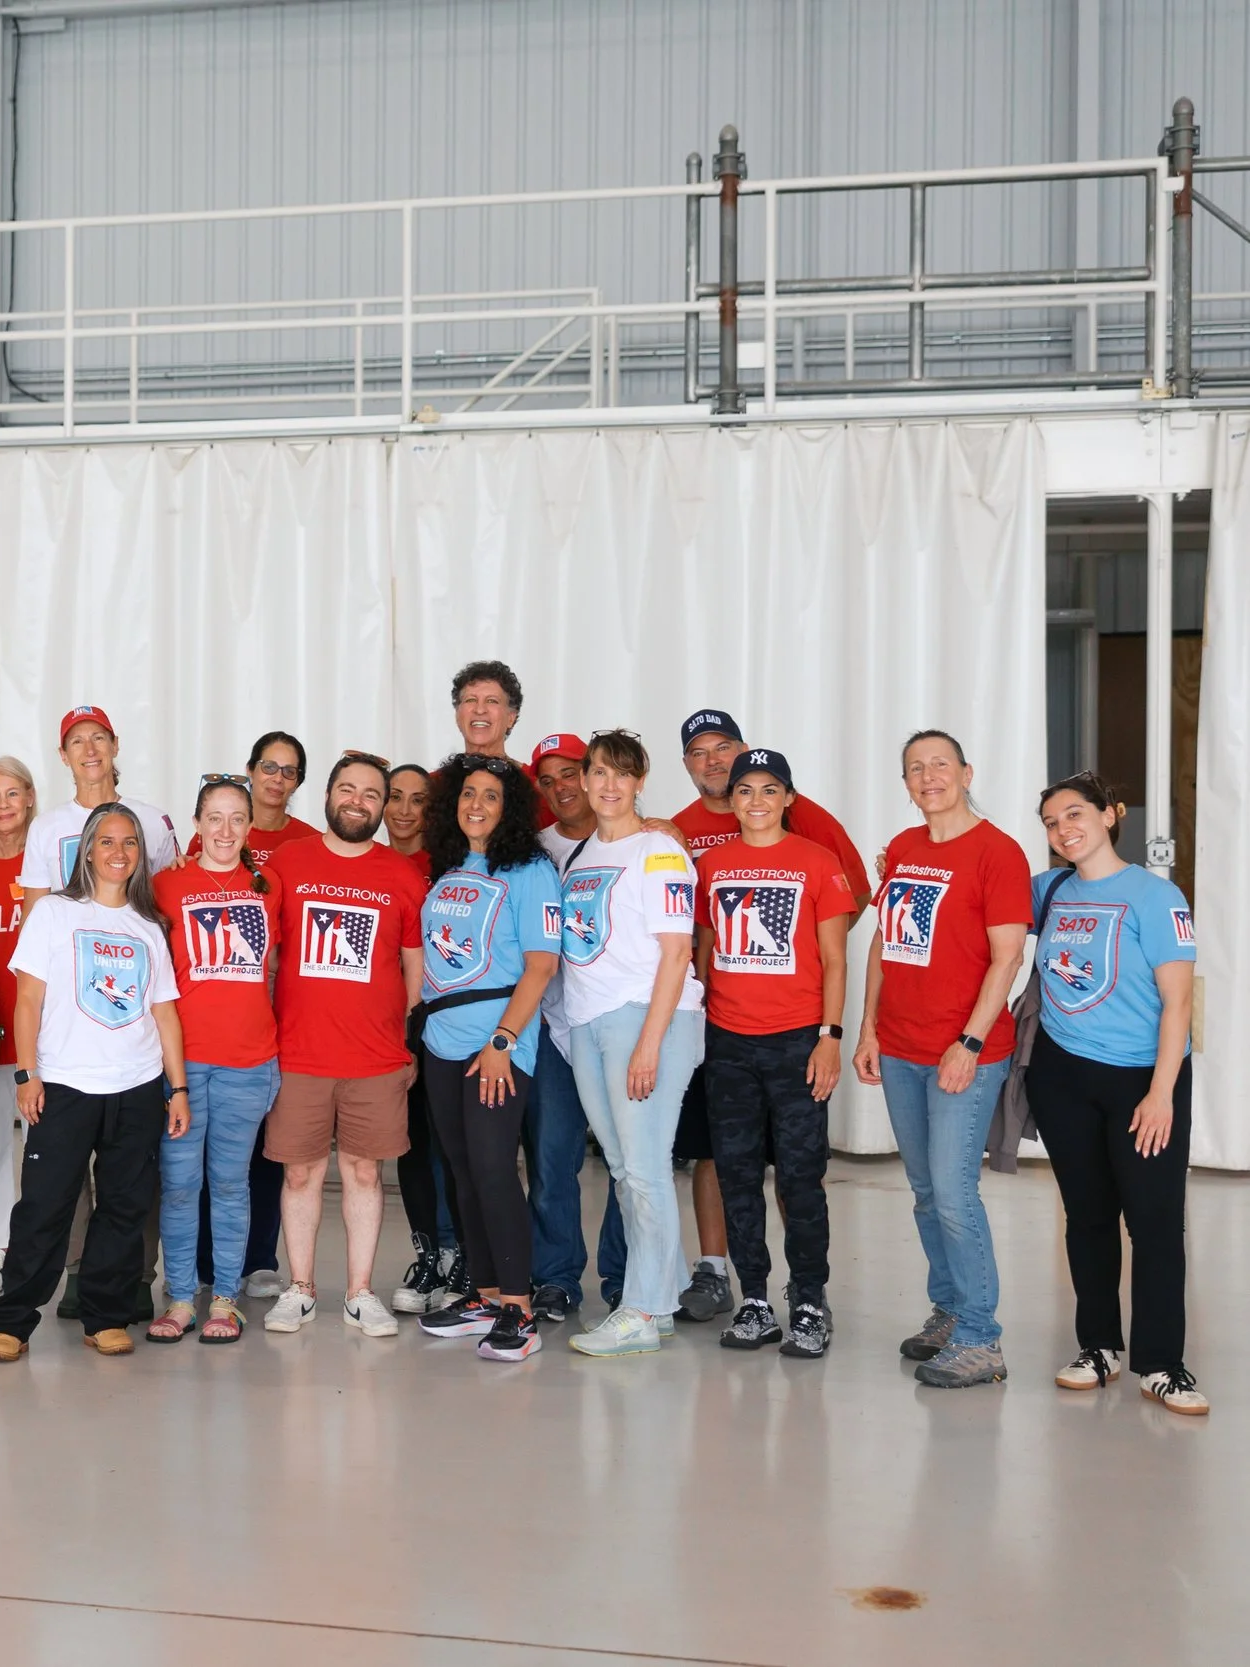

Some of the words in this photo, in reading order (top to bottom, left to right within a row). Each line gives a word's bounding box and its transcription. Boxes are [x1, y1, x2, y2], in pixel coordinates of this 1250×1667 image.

[688, 715, 704, 732] SATO
[705, 714, 721, 725] DAD
[712, 869, 806, 882] #SATOSTRONG
[895, 863, 953, 881] #satostrong
[570, 877, 602, 892] SATO
[181, 890, 264, 904] #SATOSTRONG
[296, 883, 390, 905] #SATOSTRONG
[438, 886, 479, 903] SATO
[565, 891, 595, 903] UNITED
[431, 900, 471, 917] UNITED
[1056, 916, 1098, 933] SATO
[1050, 932, 1093, 944] UNITED
[93, 941, 134, 958] SATO
[93, 955, 135, 969] UNITED
[750, 958, 790, 966] PROJECT
[337, 966, 366, 976] PROJECT
